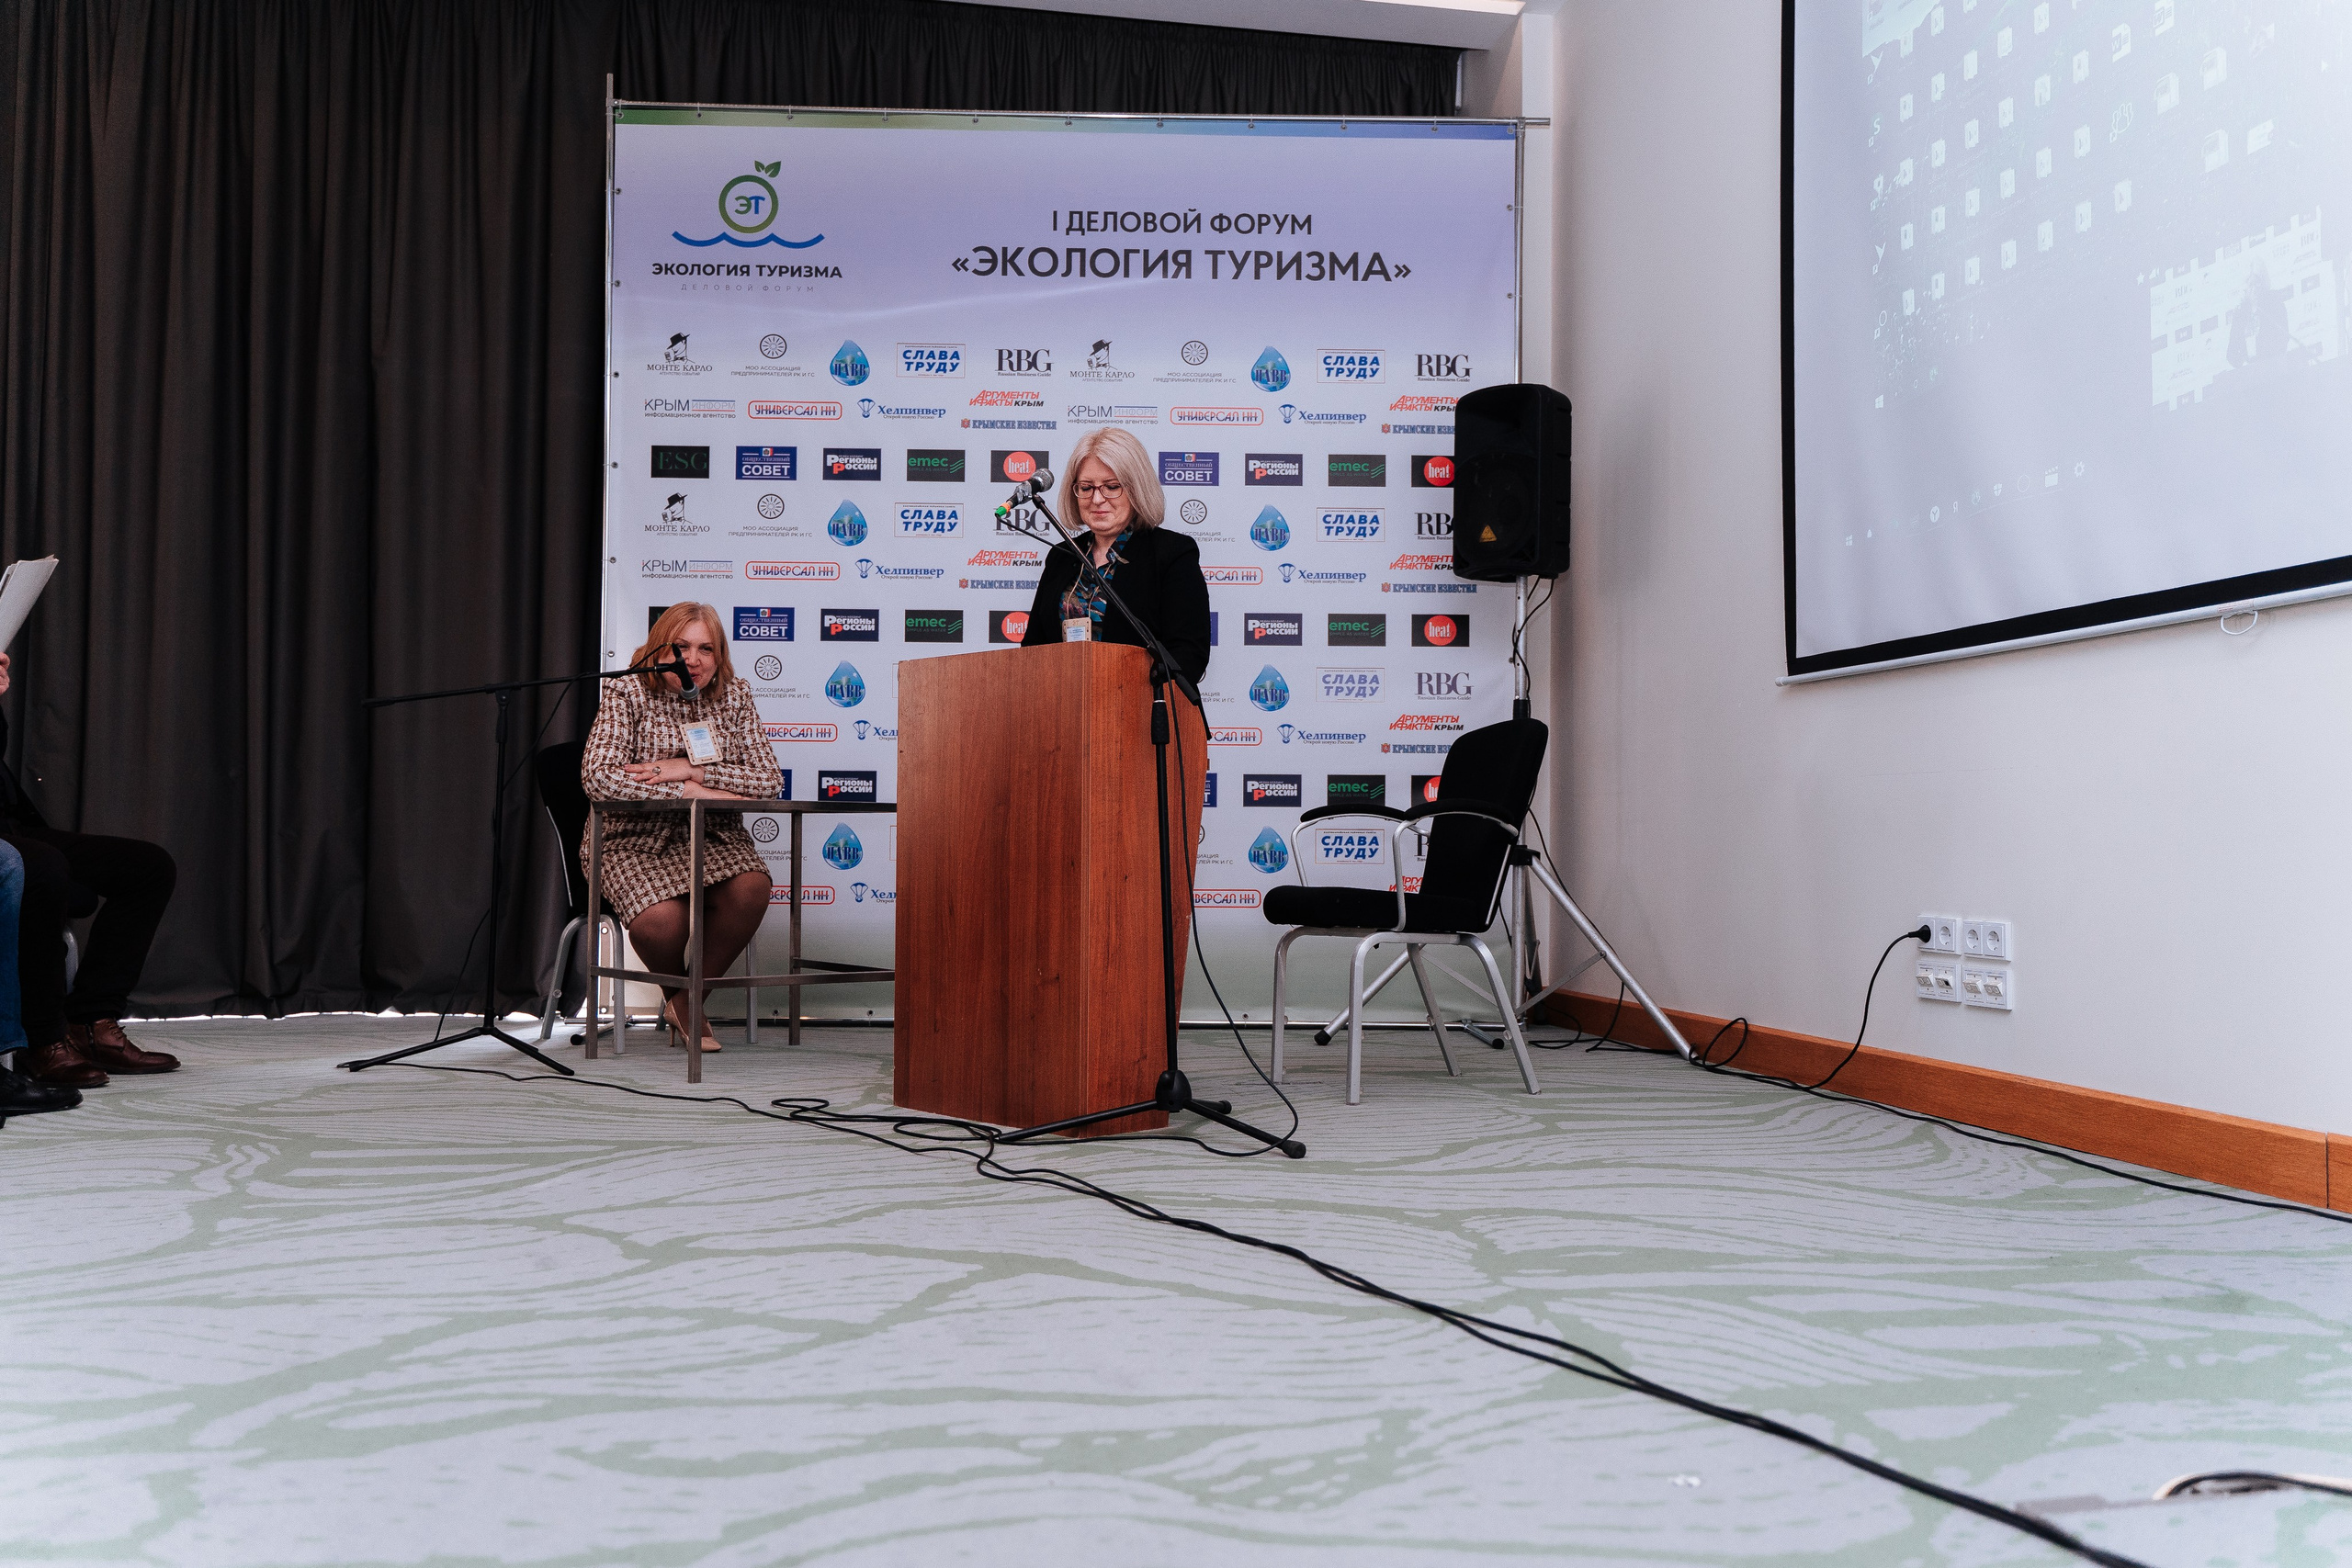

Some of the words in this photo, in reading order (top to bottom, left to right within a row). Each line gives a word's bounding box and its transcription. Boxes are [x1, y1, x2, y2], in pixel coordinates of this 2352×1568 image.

[735, 196, 765, 214] ЭТ
[1066, 209, 1201, 236] ДЕЛОВОЙ
[1210, 213, 1312, 235] ФОРУМ
[952, 246, 1192, 279] «ЭКОЛОГИЯ
[1204, 250, 1412, 282] ТУРИЗМА»
[651, 263, 751, 277] ЭКОЛОГИЯ
[755, 265, 842, 279] ТУРИЗМА
[681, 283, 752, 291] ДЕЛОВОЙ
[902, 350, 960, 360] СЛАВА
[995, 349, 1055, 372] RBG
[1323, 355, 1380, 366] СЛАВА
[904, 361, 960, 374] ТРУДУ
[1415, 355, 1474, 378] RBG
[1325, 367, 1380, 379] ТРУДУ
[976, 390, 1039, 400] АРГУМЕНТЫ
[645, 400, 689, 411] КРЫМ
[755, 405, 818, 415] УНИВЕРСАЛ
[1069, 406, 1112, 417] КРЫМ
[877, 406, 946, 418] Хелпинвер
[1177, 411, 1239, 422] УНИВЕРСАЛ
[1298, 412, 1367, 423] Хелпинвер
[972, 420, 1016, 429] КРЫМСКИЕ
[1017, 421, 1057, 430] ИЗВЕСТИЯ
[1393, 424, 1436, 434] КРЫМСКИЕ
[659, 452, 707, 469] ESG
[827, 455, 877, 467] Регионы
[909, 457, 948, 467] emec
[1008, 458, 1030, 473] heat
[1249, 460, 1299, 472] Регионы
[742, 466, 790, 475] СОВЕТ
[833, 463, 877, 475] России
[1330, 462, 1369, 472] emec
[1429, 463, 1450, 478] heat
[1165, 471, 1213, 480] СОВЕТ
[1255, 468, 1299, 480] России
[900, 510, 958, 520] СЛАВА
[1322, 514, 1380, 525] СЛАВА
[902, 521, 958, 534] ТРУДУ
[1324, 525, 1380, 538] ТРУДУ
[974, 550, 1037, 559] АРГУМЕНТЫ
[642, 560, 686, 571] КРЫМ
[752, 566, 815, 576] УНИВЕРСАЛ
[876, 566, 944, 578] Хелпинвер
[1298, 570, 1366, 582] Хелпинвер
[970, 580, 1014, 589] КРЫМСКИЕ
[1393, 583, 1436, 592] КРЫМСКИЕ
[1437, 584, 1476, 593] ИЗВЕСТИЯ
[824, 615, 875, 627] Регионы
[907, 618, 946, 627] emec
[1249, 619, 1298, 631] Регионы
[1329, 622, 1369, 631] emec
[740, 626, 787, 636] СОВЕТ
[831, 624, 875, 636] России
[1255, 628, 1298, 639] России
[1429, 622, 1451, 637] heat
[1322, 674, 1379, 684] СЛАВА
[1415, 672, 1475, 695] RBG
[1324, 685, 1379, 698] ТРУДУ
[1396, 714, 1459, 723] АРГУМЕНТЫ
[1297, 731, 1366, 743] Хелпинвер
[1392, 744, 1436, 754] КРЫМСКИЕ
[822, 777, 873, 789] Регионы
[1247, 781, 1297, 793] Регионы
[1329, 783, 1369, 792] emec
[829, 785, 873, 797] России
[1253, 789, 1297, 801] России
[1321, 836, 1379, 846] СЛАВА
[1323, 847, 1379, 860] ТРУДУ
